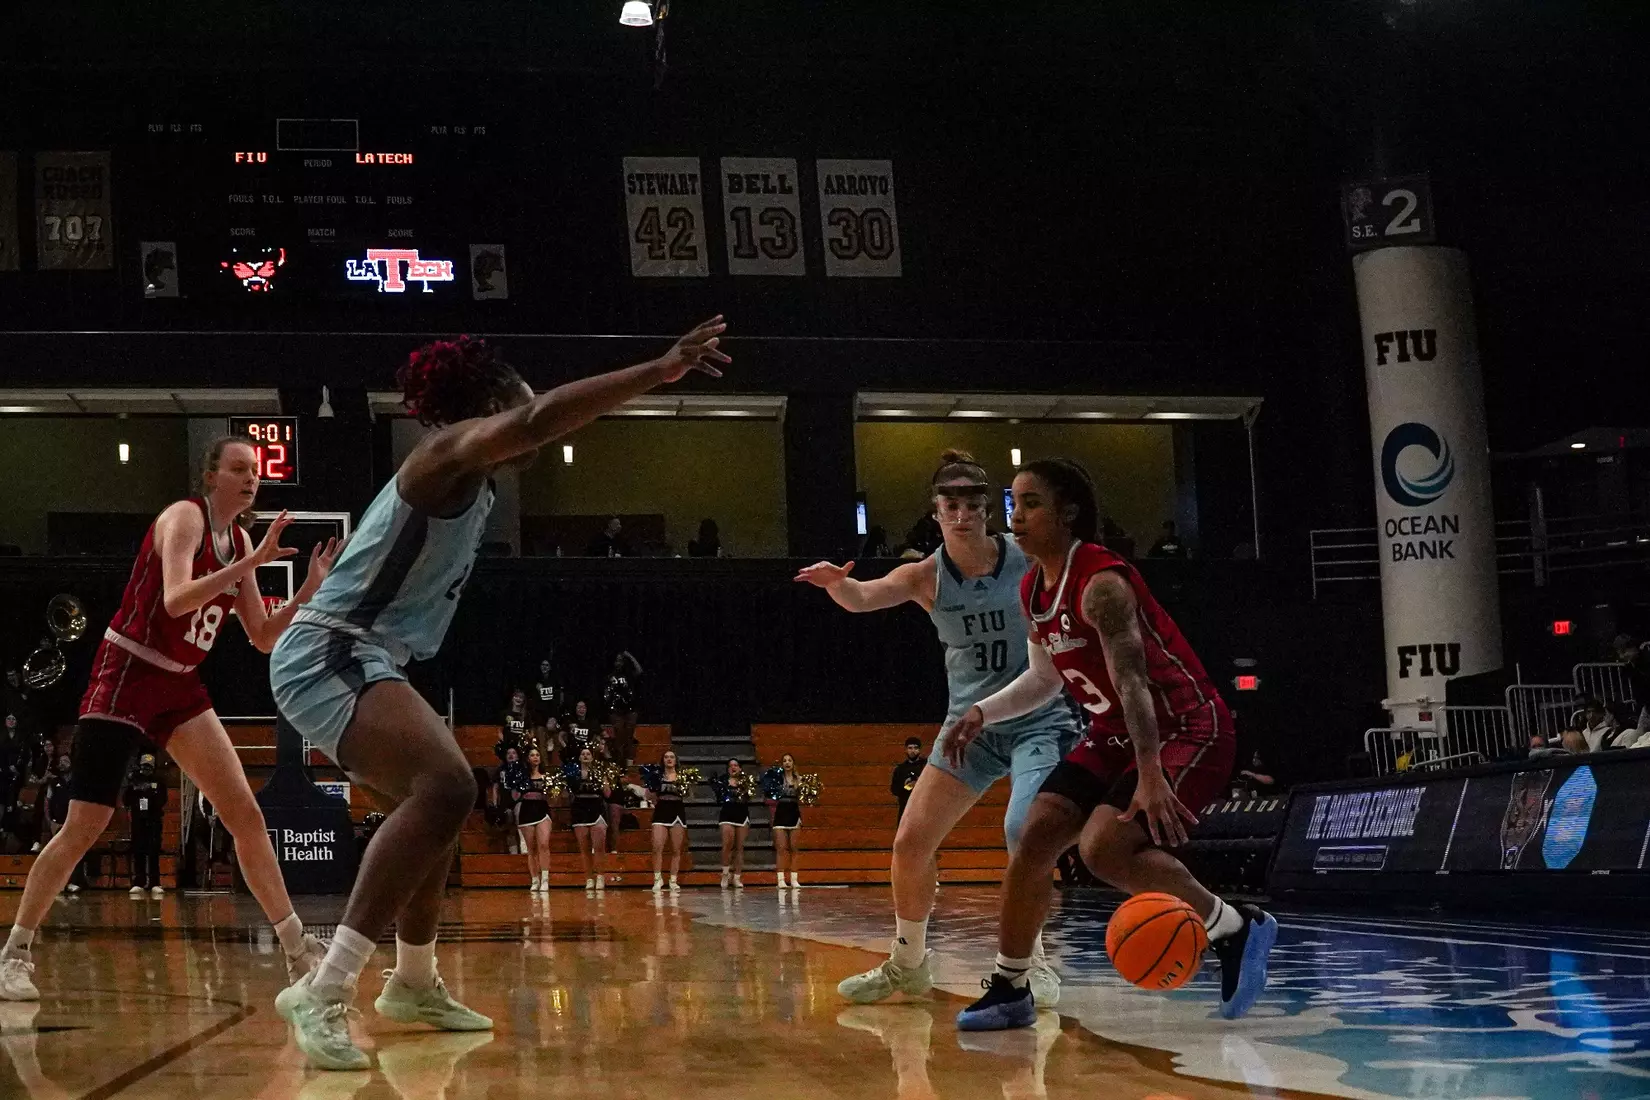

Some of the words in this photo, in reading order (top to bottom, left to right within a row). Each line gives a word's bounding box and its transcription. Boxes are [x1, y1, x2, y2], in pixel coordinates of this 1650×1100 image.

[235, 151, 268, 163] FIU
[627, 172, 698, 195] STEWART
[726, 173, 793, 195] BELL
[823, 173, 890, 196] ARROYO
[228, 194, 254, 204] FOULS
[293, 195, 324, 204] PLAYER
[326, 195, 348, 205] FOUL
[386, 195, 413, 205] FOULS
[1382, 188, 1422, 236] 2
[44, 214, 104, 241] 707
[229, 227, 256, 237] SCORE
[307, 227, 336, 237] MATCH
[387, 227, 414, 237] SCORE
[635, 206, 698, 261] 42
[729, 206, 799, 260] 13
[827, 207, 895, 261] 30
[1352, 224, 1378, 239] S.E.
[1374, 329, 1437, 366] FIU
[248, 423, 291, 442] 9:01
[1385, 514, 1460, 538] OCEAN
[1392, 540, 1455, 562] BANK
[183, 604, 224, 652] 18
[962, 610, 1006, 636] FIU
[974, 640, 1007, 673] 30
[1397, 643, 1461, 680] FIU
[1061, 668, 1112, 715] 3
[1305, 793, 1335, 840] THE
[1324, 789, 1377, 840] PANTHER
[1364, 786, 1427, 839] EXCHANGE
[282, 828, 336, 846] Baptist
[284, 846, 333, 861] Health
